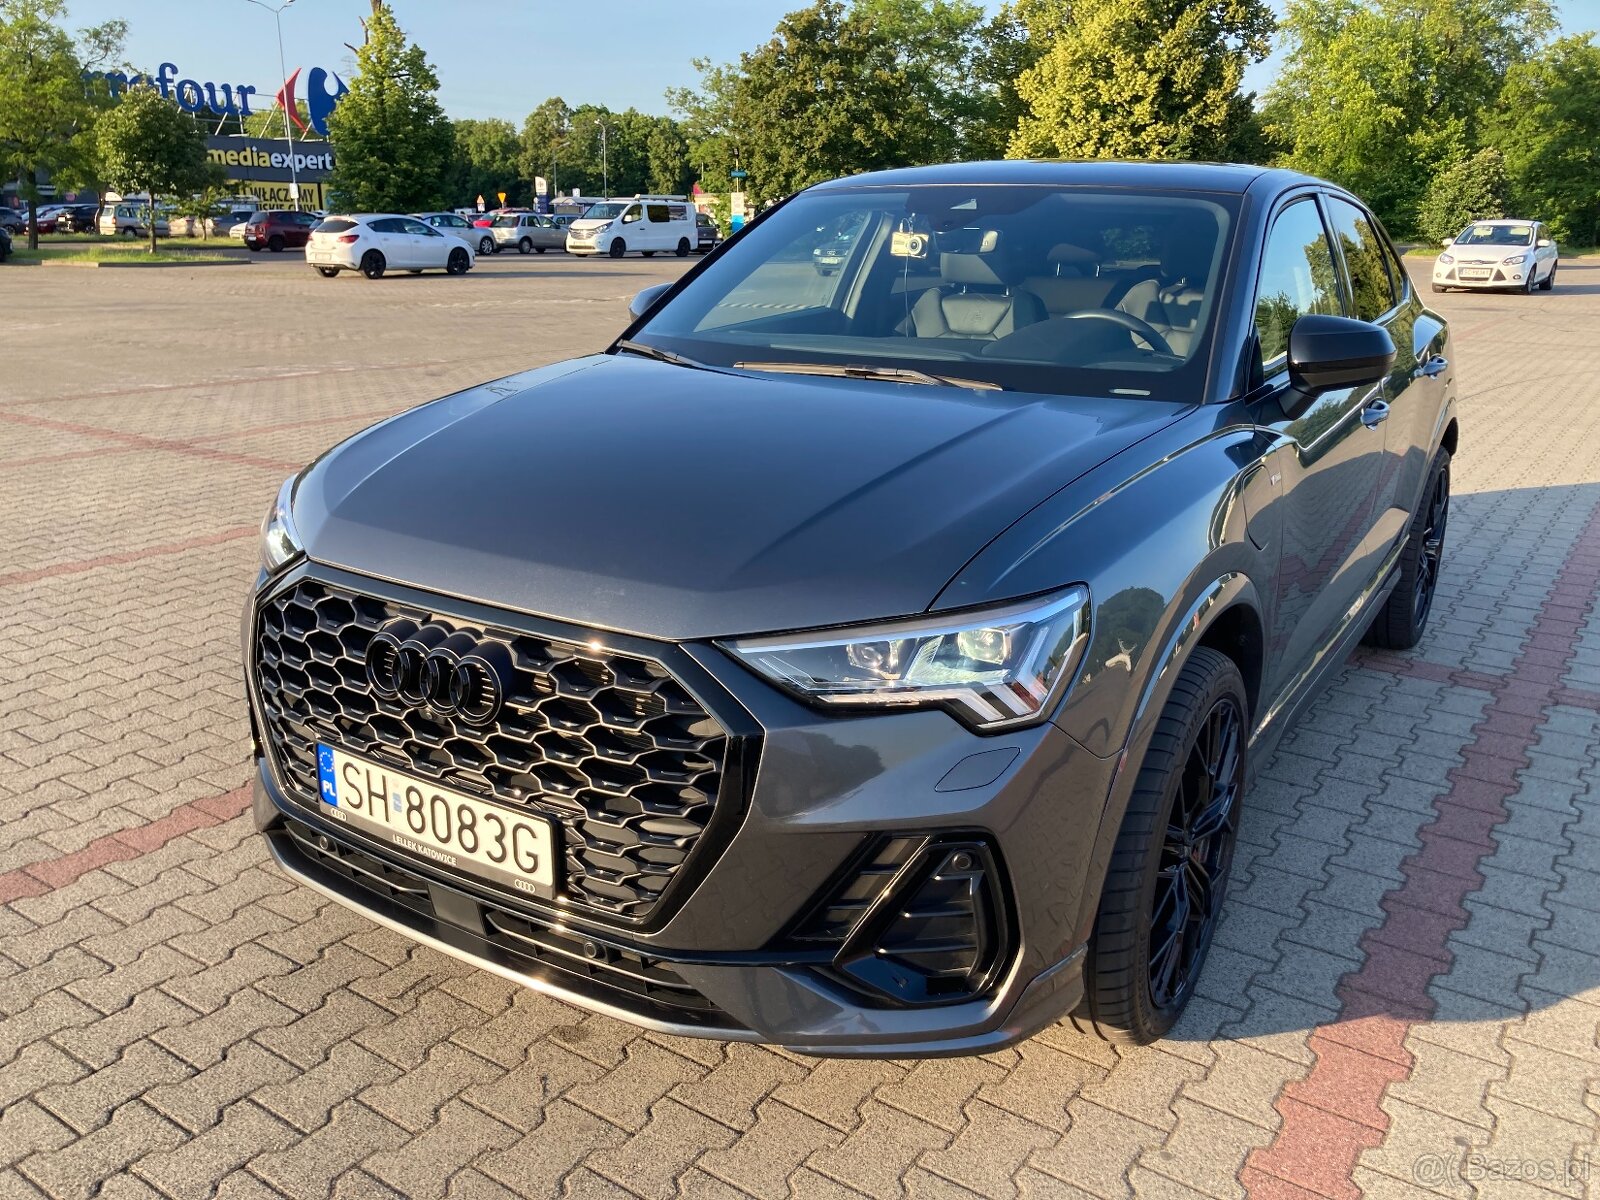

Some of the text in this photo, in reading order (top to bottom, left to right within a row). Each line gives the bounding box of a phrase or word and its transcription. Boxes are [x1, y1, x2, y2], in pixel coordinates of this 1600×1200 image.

[323, 780, 336, 797] PL
[342, 761, 540, 874] SH 8083G
[392, 834, 457, 867] LELLEK KATOWICE
